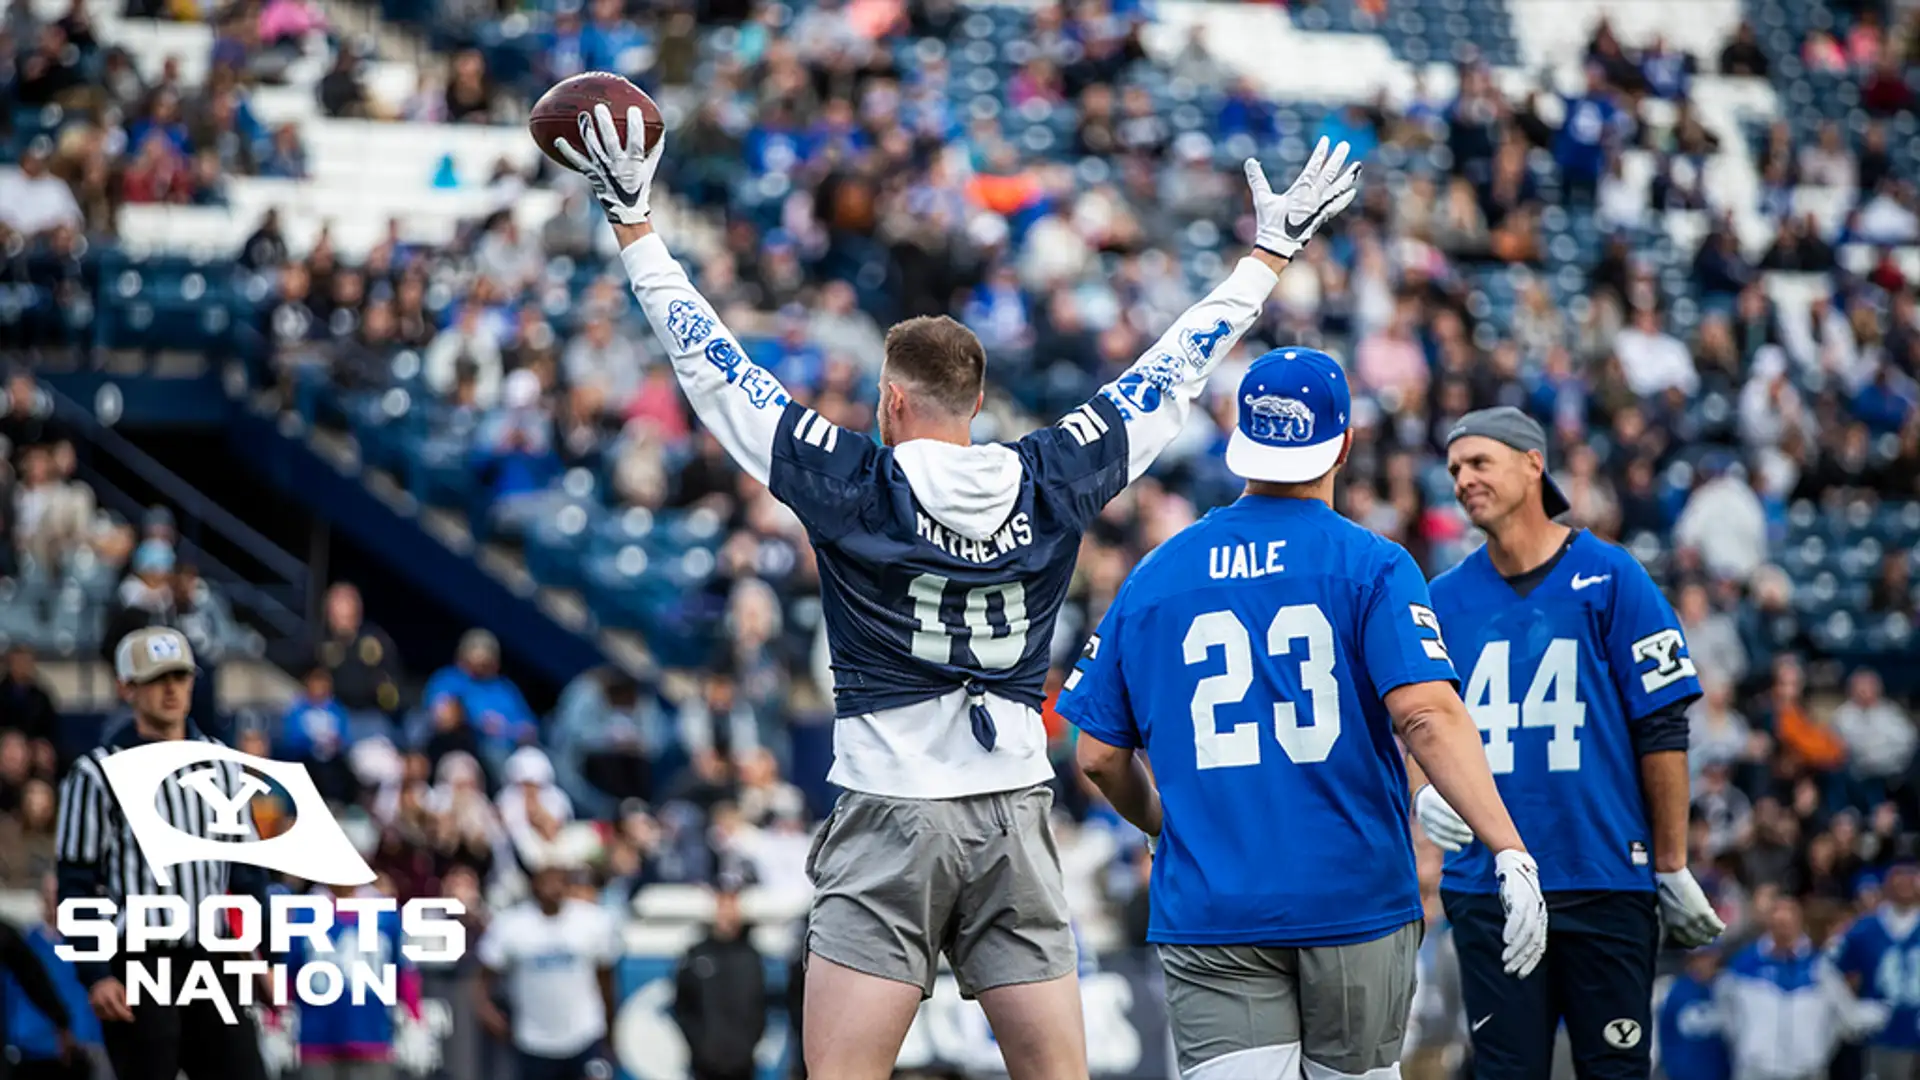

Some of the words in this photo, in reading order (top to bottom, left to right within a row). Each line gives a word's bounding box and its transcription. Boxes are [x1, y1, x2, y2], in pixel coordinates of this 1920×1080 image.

[1251, 411, 1315, 441] BYU
[916, 511, 1033, 563] MATHEWS
[1209, 540, 1286, 579] UALE
[907, 572, 1030, 669] 10
[1182, 603, 1341, 770] 23
[1631, 629, 1697, 693] Y
[1464, 638, 1586, 774] 44
